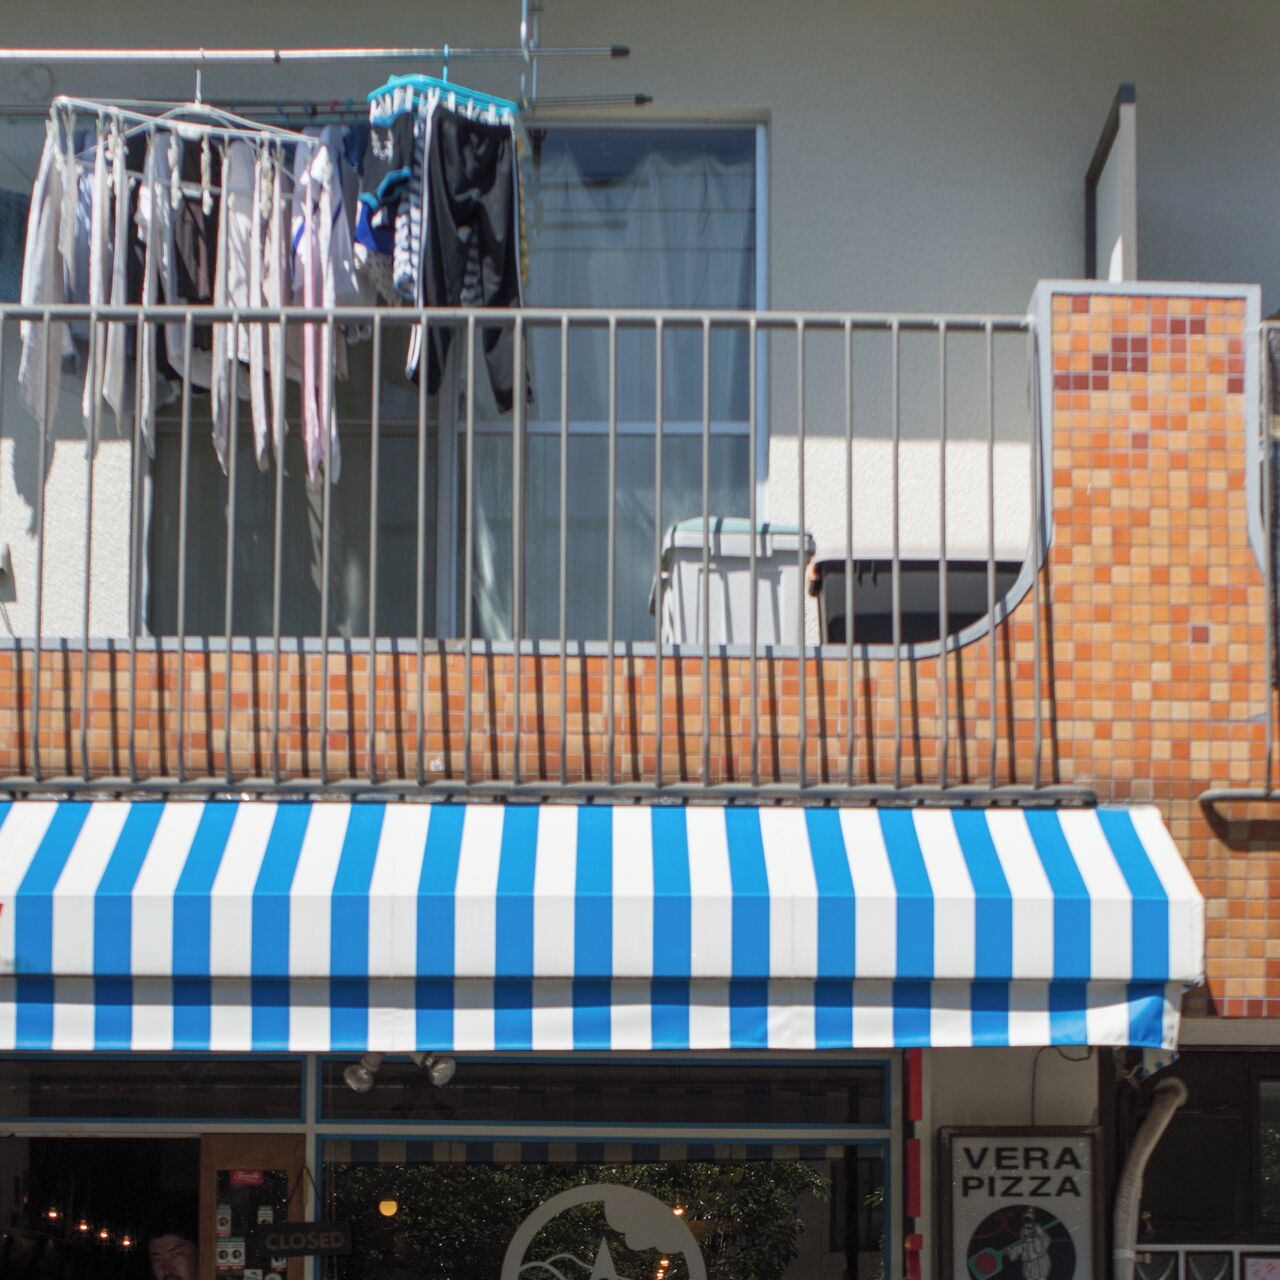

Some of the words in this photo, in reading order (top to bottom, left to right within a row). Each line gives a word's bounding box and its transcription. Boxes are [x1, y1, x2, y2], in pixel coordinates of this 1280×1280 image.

[962, 1147, 1083, 1170] VERA
[961, 1176, 1082, 1198] PIZZA
[265, 1231, 345, 1250] CLOSED
